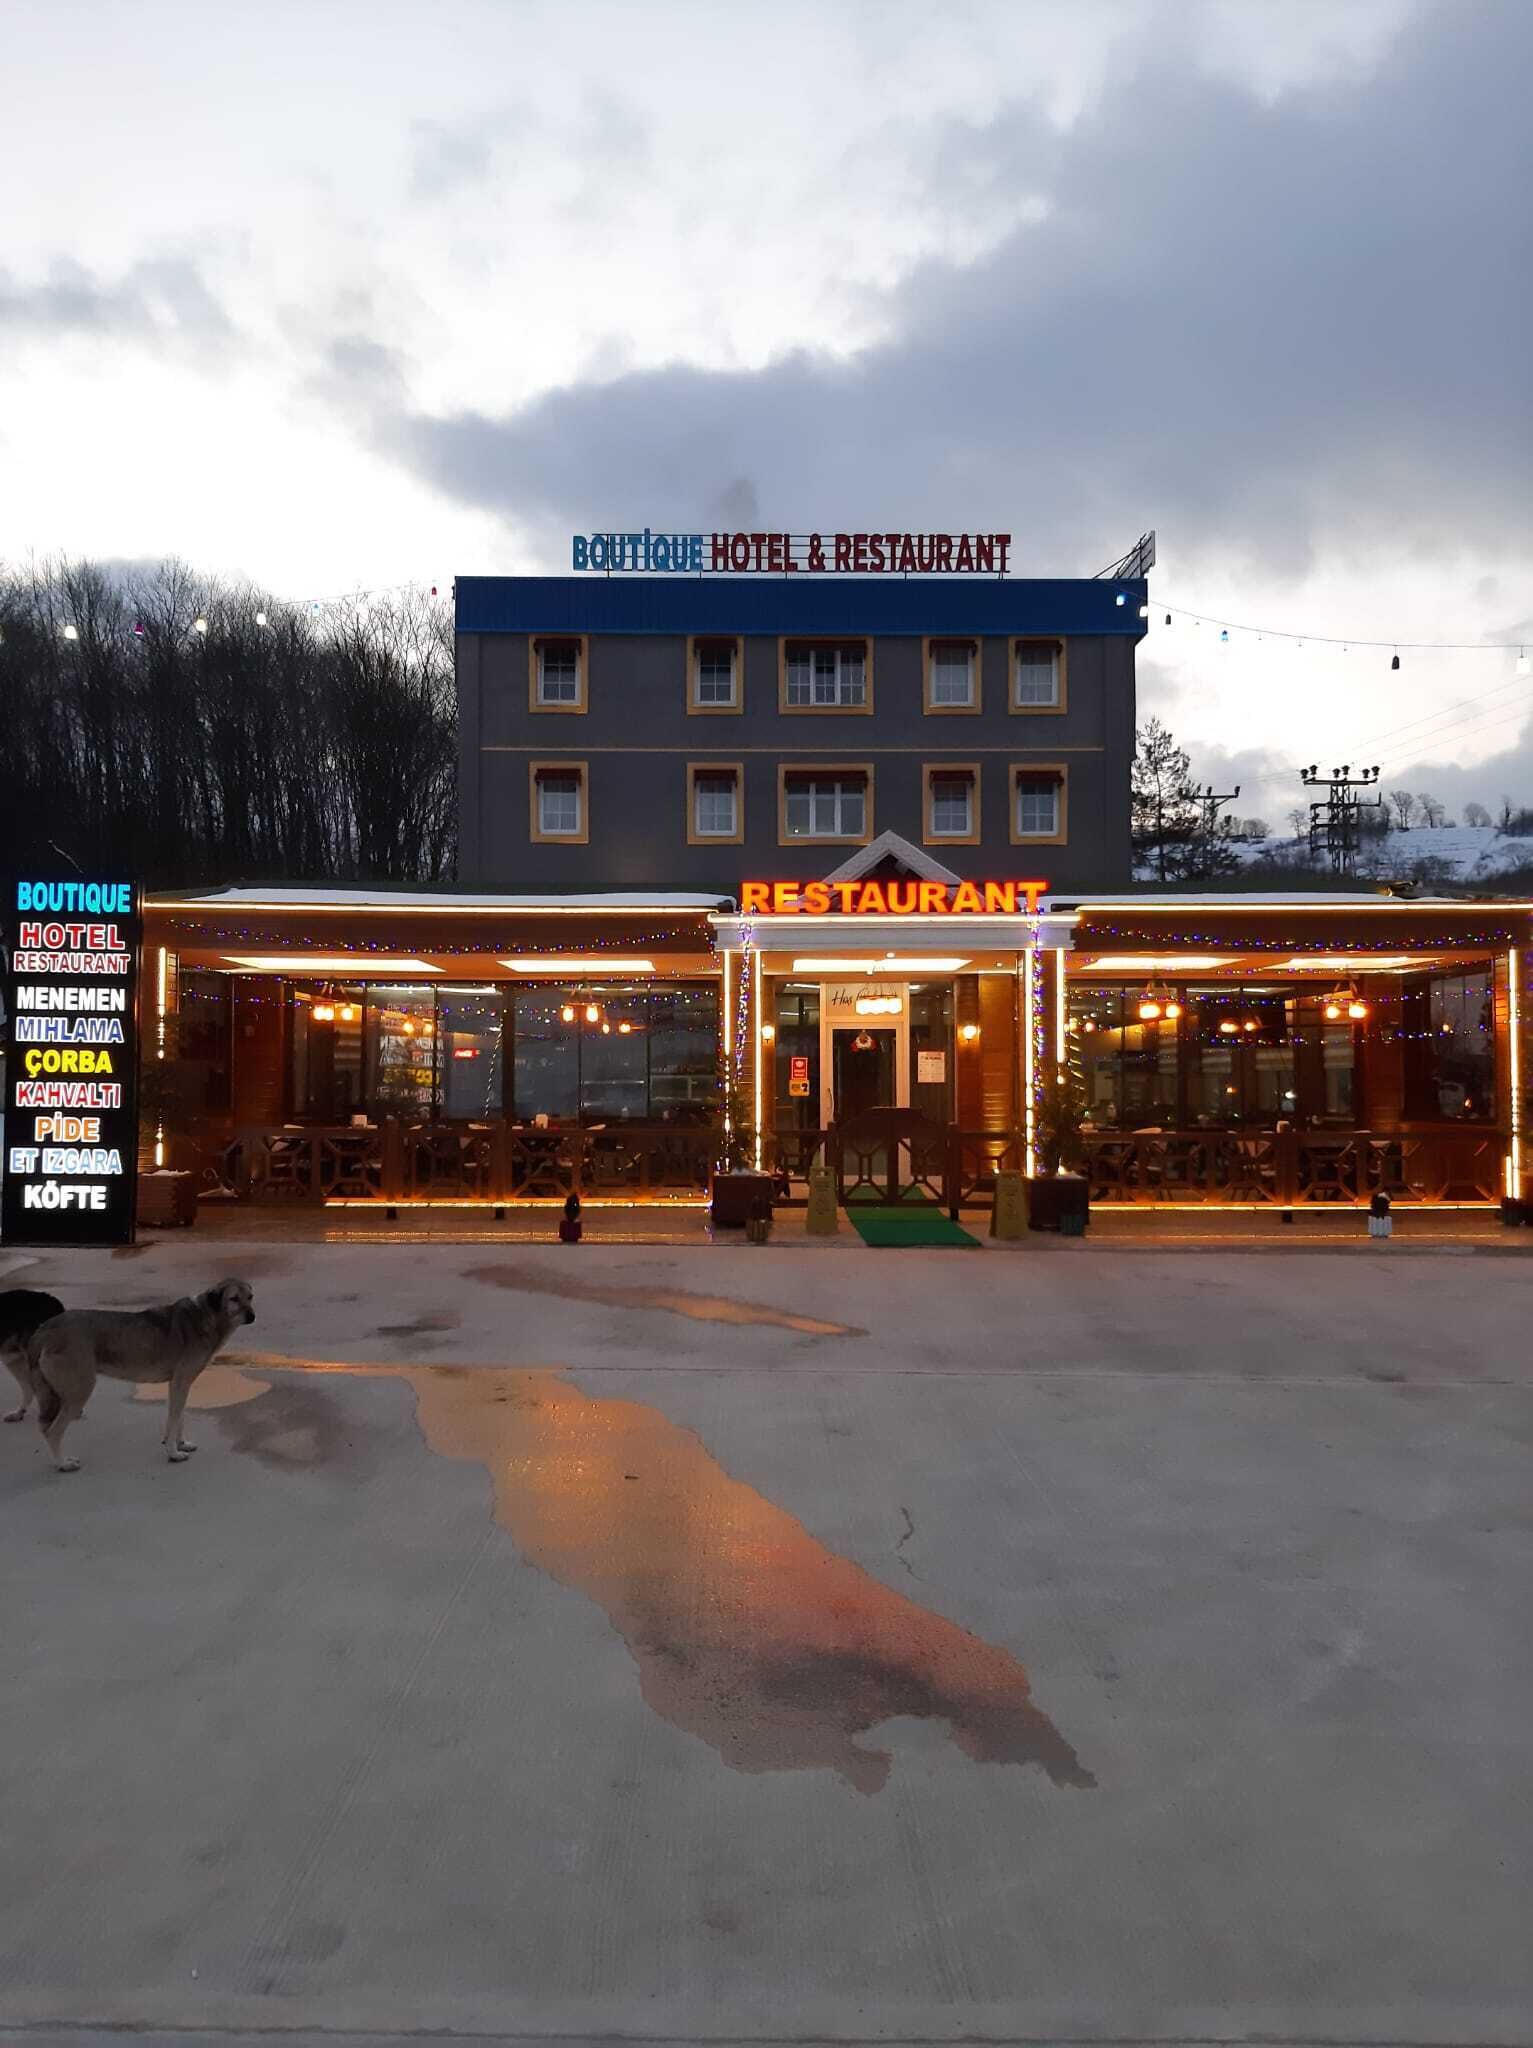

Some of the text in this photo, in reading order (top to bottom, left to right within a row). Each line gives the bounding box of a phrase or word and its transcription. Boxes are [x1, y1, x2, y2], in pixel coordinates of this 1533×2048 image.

[711, 533, 798, 571] HOTEL
[808, 533, 825, 571] &
[834, 534, 1010, 572] RESTAURANT
[17, 882, 131, 914] BOUTIQUE
[741, 881, 1048, 913] RESTAURANT
[20, 922, 126, 950] HOTEL
[13, 951, 131, 975] RESTAURANT
[16, 986, 126, 1011] MENEMEN
[15, 1016, 125, 1043] MIHLAMA
[25, 1049, 113, 1078] ÇORBA
[16, 1082, 121, 1108] KAHVALTI
[35, 1111, 100, 1142] PİDE
[9, 1148, 123, 1174] ET IZGARA
[24, 1180, 107, 1209] KÖFTE
